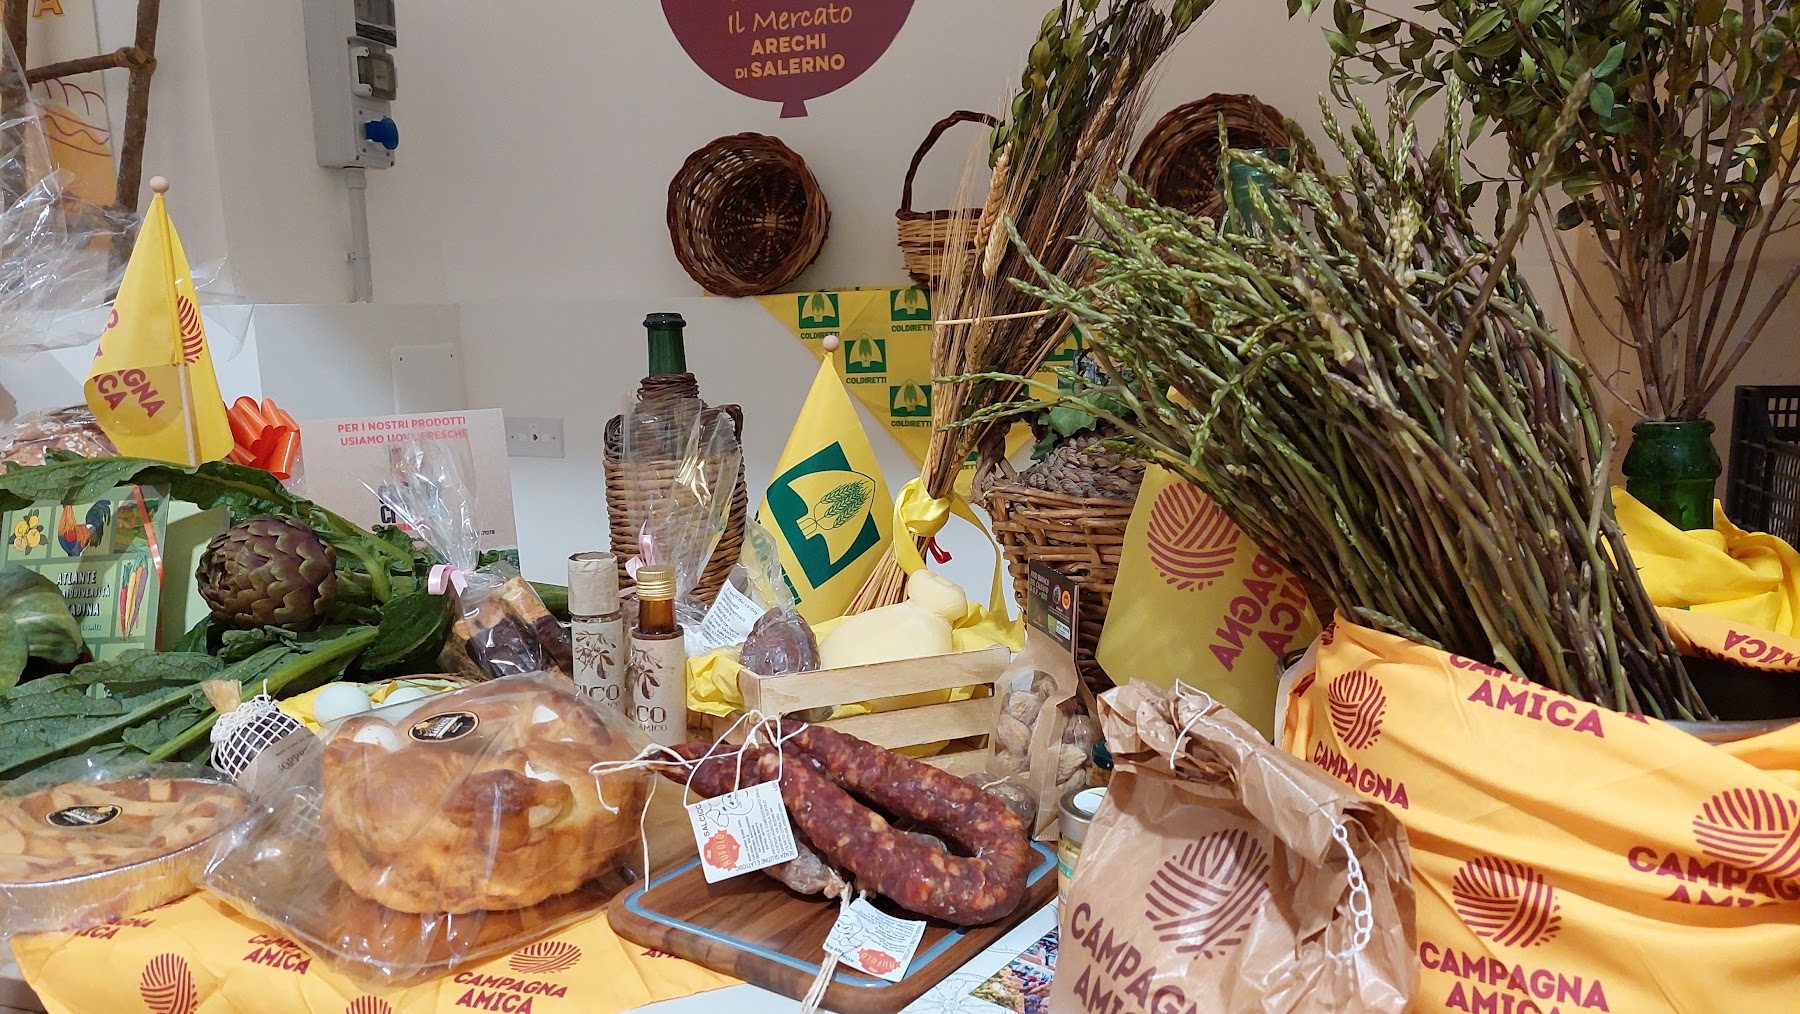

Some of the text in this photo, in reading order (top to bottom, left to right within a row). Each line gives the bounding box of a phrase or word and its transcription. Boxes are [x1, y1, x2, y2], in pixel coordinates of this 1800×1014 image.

[728, 3, 853, 34] Il Mercato
[751, 33, 827, 56] ARECHI
[734, 53, 846, 79] DI SALERNO
[846, 376, 887, 385] COLDIRETTI
[338, 416, 466, 433] PER I NOSTRI PRODOTTI
[891, 420, 932, 428] COLDIRETTI
[340, 434, 385, 447] USIAMO
[56, 570, 97, 586] ATLANTE
[68, 603, 100, 617] ADINA
[1724, 630, 1797, 667] ICA
[637, 705, 667, 723] CO
[1467, 679, 1605, 739] AMICA
[1314, 740, 1409, 810] CAMPAGNA
[716, 833, 732, 869] RUFOLO
[1627, 846, 1800, 901] CAMPAG
[242, 947, 312, 975] AMICA
[1071, 902, 1197, 1014] CAMPAG
[453, 971, 568, 998] CAMPAGNA
[1419, 941, 1610, 1013] CAMPAGNA
[455, 988, 534, 1014] AMICA
